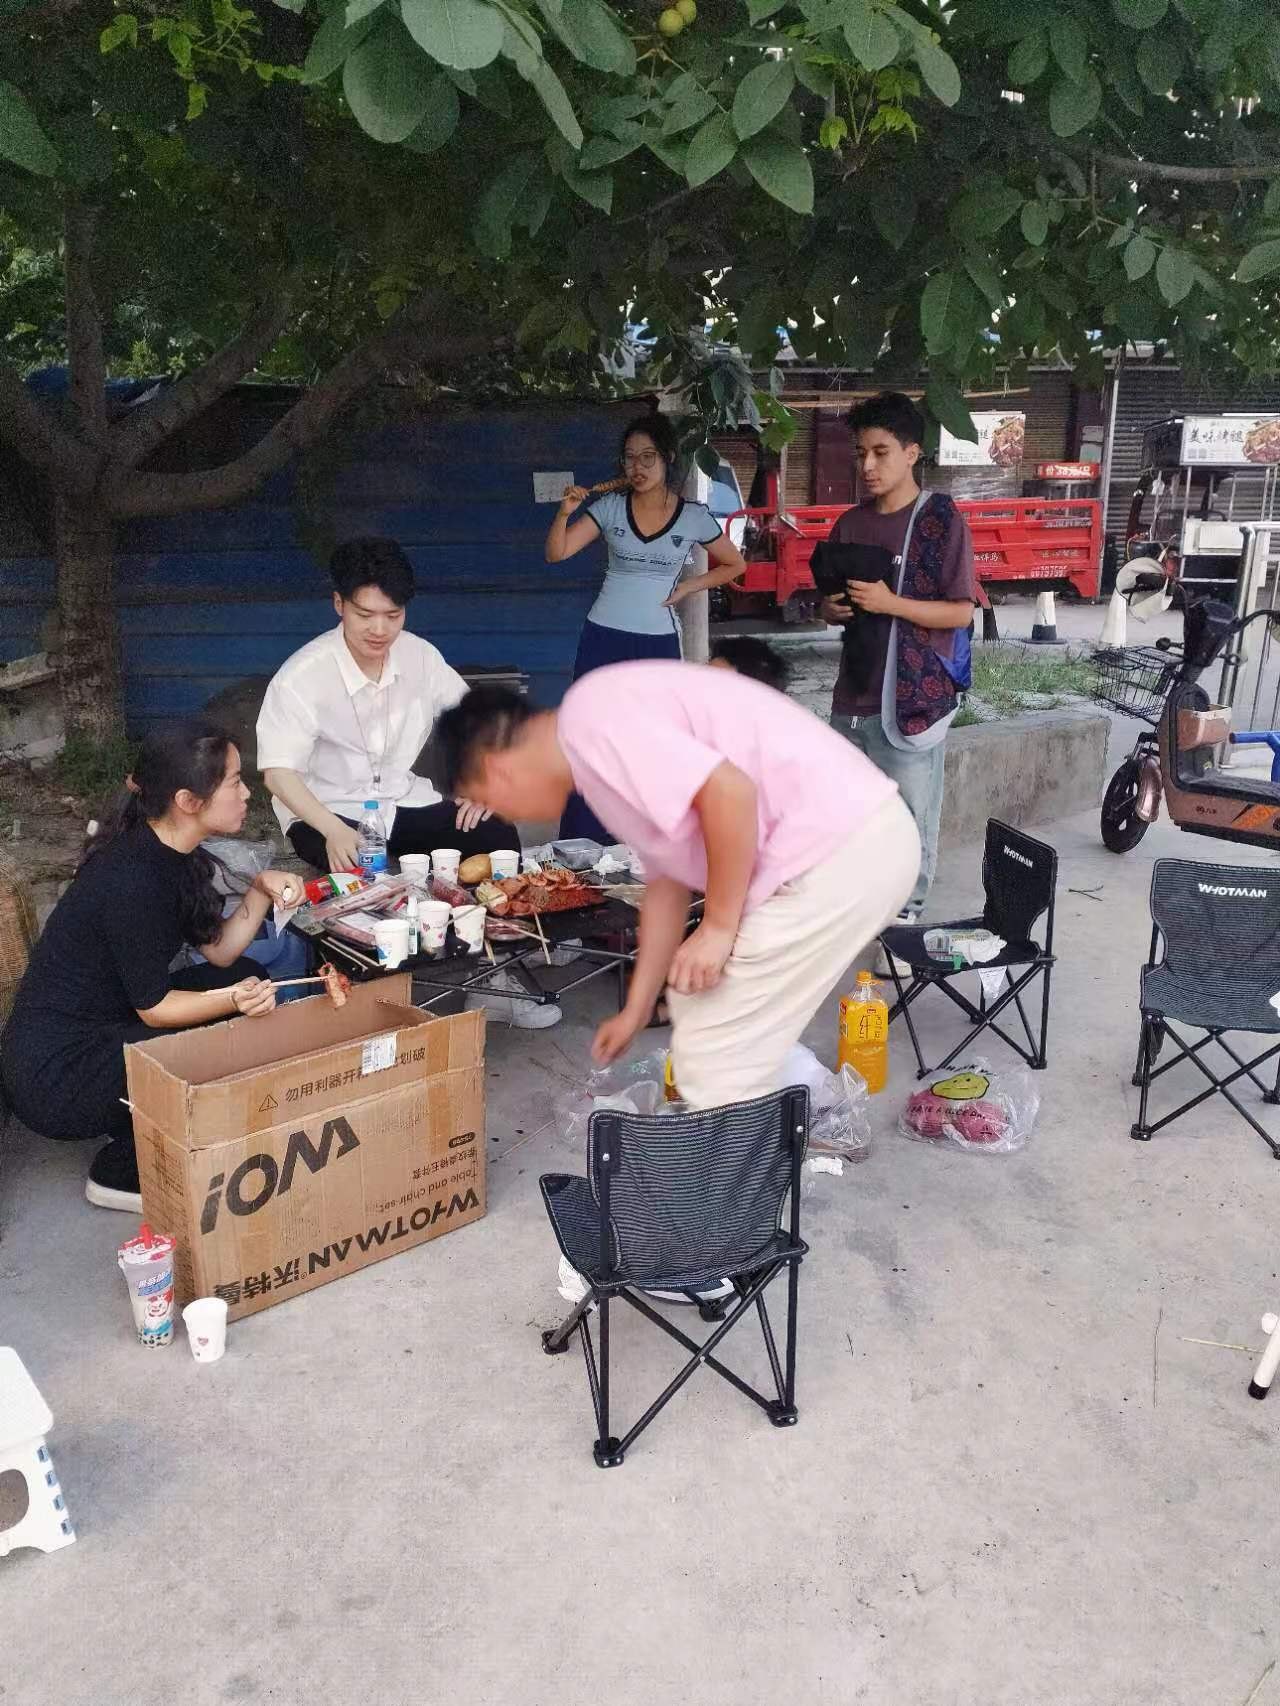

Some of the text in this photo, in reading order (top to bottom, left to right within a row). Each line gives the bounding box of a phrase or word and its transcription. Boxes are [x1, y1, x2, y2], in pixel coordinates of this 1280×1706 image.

[1003, 844, 1034, 869] WHOTMAN
[1198, 882, 1268, 898] WHOTMAN
[285, 1047, 427, 1103] 勿用利器开划破
[428, 1178, 448, 1195] and
[451, 1168, 478, 1183] Table
[308, 1187, 480, 1275] WHOTMAN
[213, 1257, 300, 1306] 沃特曼
